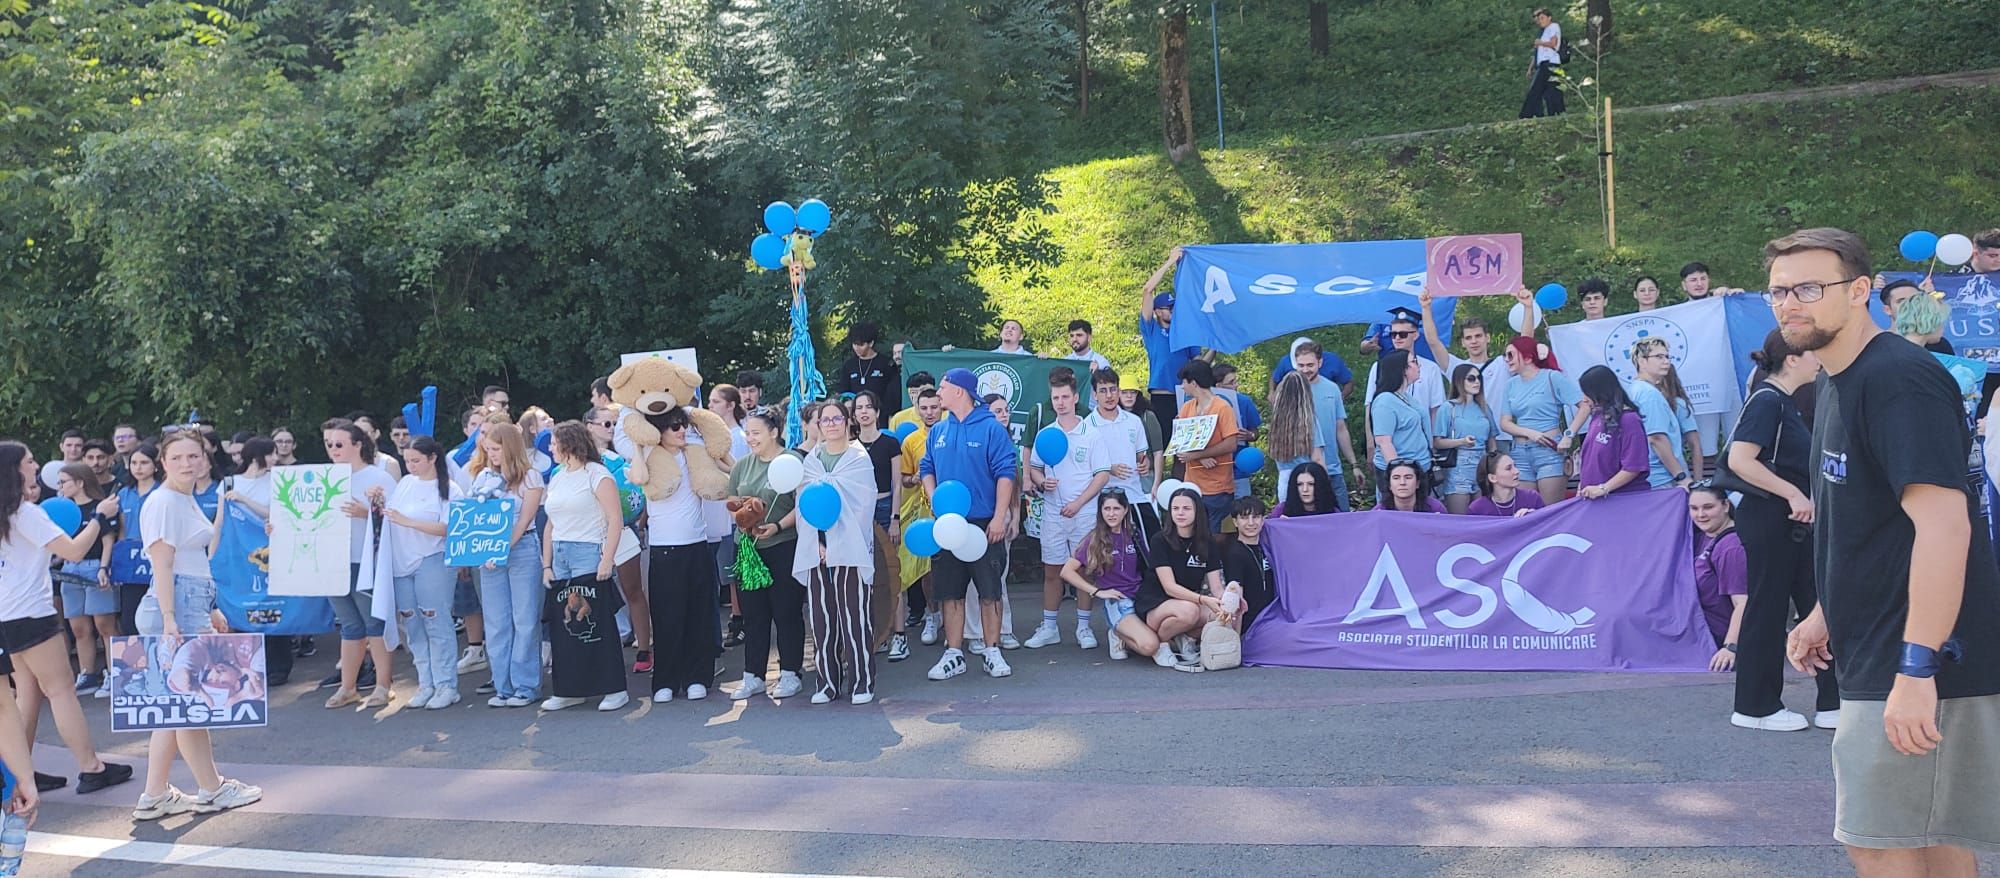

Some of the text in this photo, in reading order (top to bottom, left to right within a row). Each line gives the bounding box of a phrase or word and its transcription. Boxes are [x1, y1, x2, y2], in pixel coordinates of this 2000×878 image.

[1444, 253, 1502, 275] ASM
[1626, 319, 1655, 329] SNSPA
[293, 487, 323, 503] AVSE
[450, 507, 475, 536] 25
[474, 512, 486, 526] DE
[450, 538, 509, 557] UN SUFLET
[1341, 532, 1596, 635] ASC
[1493, 635, 1508, 650] LA
[1512, 633, 1597, 651] COMUNICARE
[114, 702, 260, 726] VESTUL
